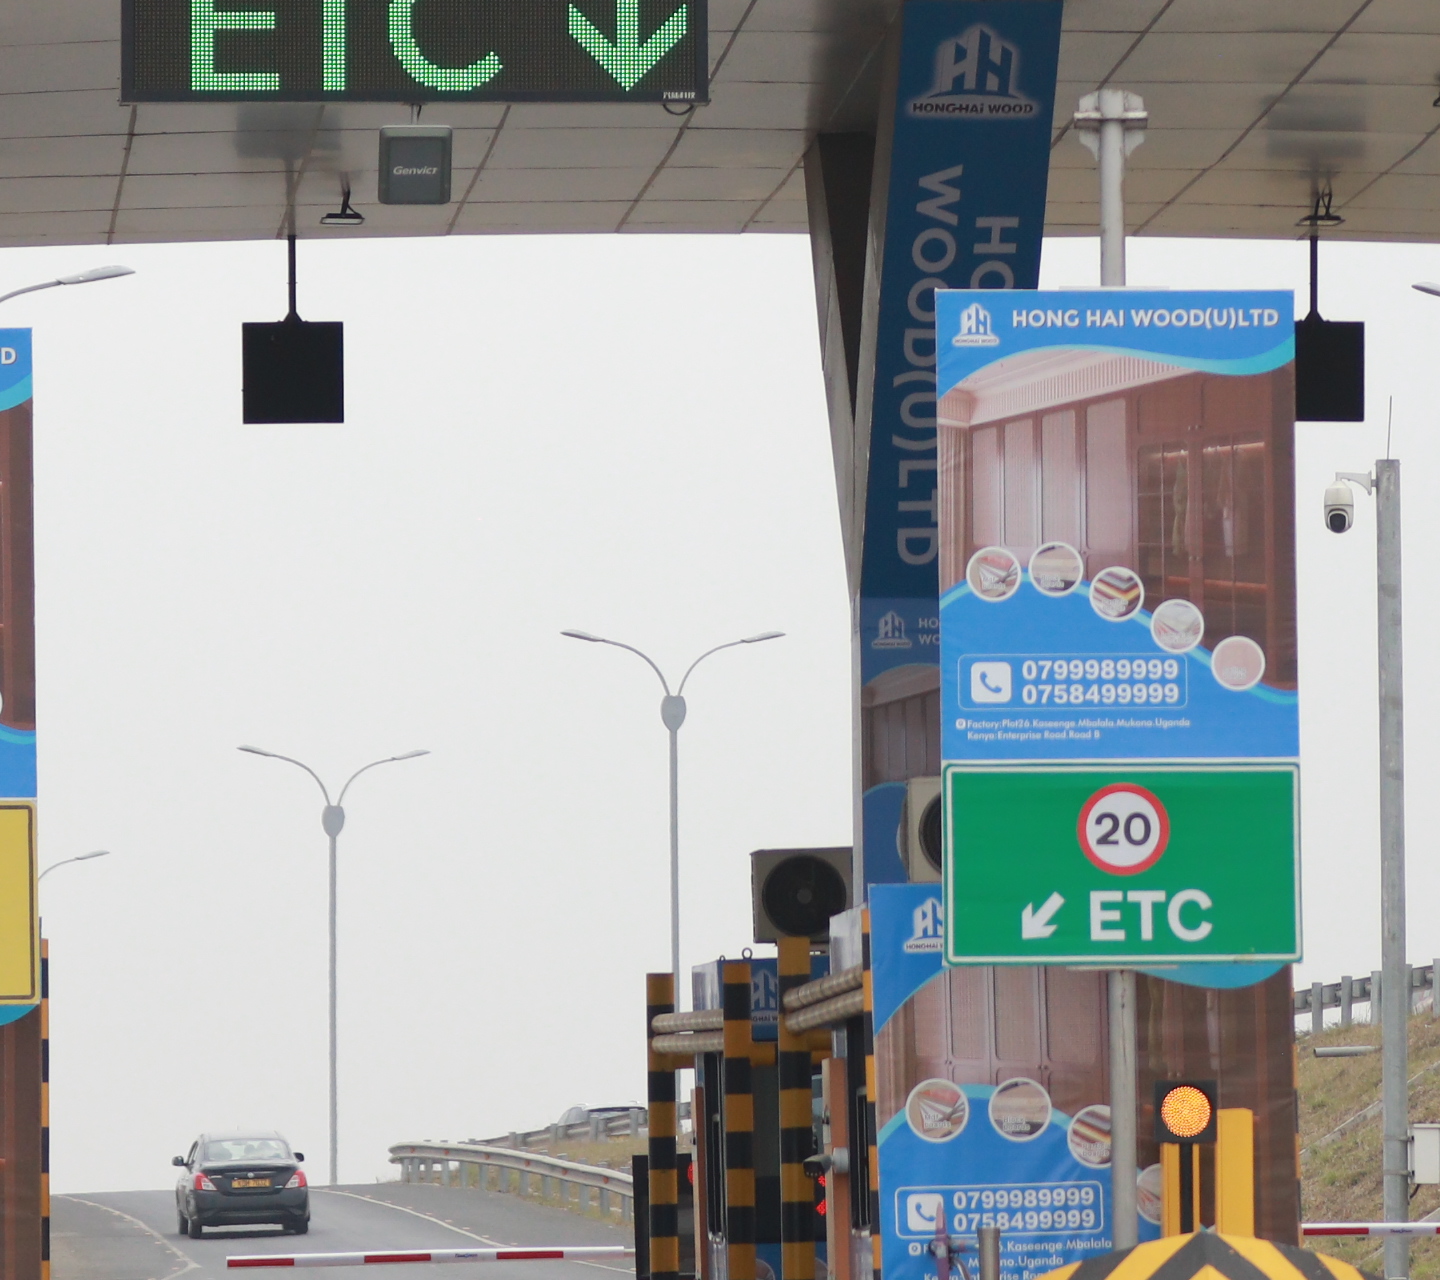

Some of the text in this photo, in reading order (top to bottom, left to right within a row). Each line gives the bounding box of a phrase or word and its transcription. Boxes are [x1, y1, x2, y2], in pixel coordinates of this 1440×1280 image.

[988, 103, 1034, 114] WOOD
[1012, 307, 1280, 330] HONG HAI WOOD(U)LTD
[1021, 659, 1179, 680] 0799989999
[1021, 683, 1180, 704] 0758499999
[1094, 812, 1152, 846] 20
[1089, 889, 1213, 942] ETC
[952, 1187, 1095, 1209] 0799989999
[953, 1209, 1096, 1231] 0758499999
